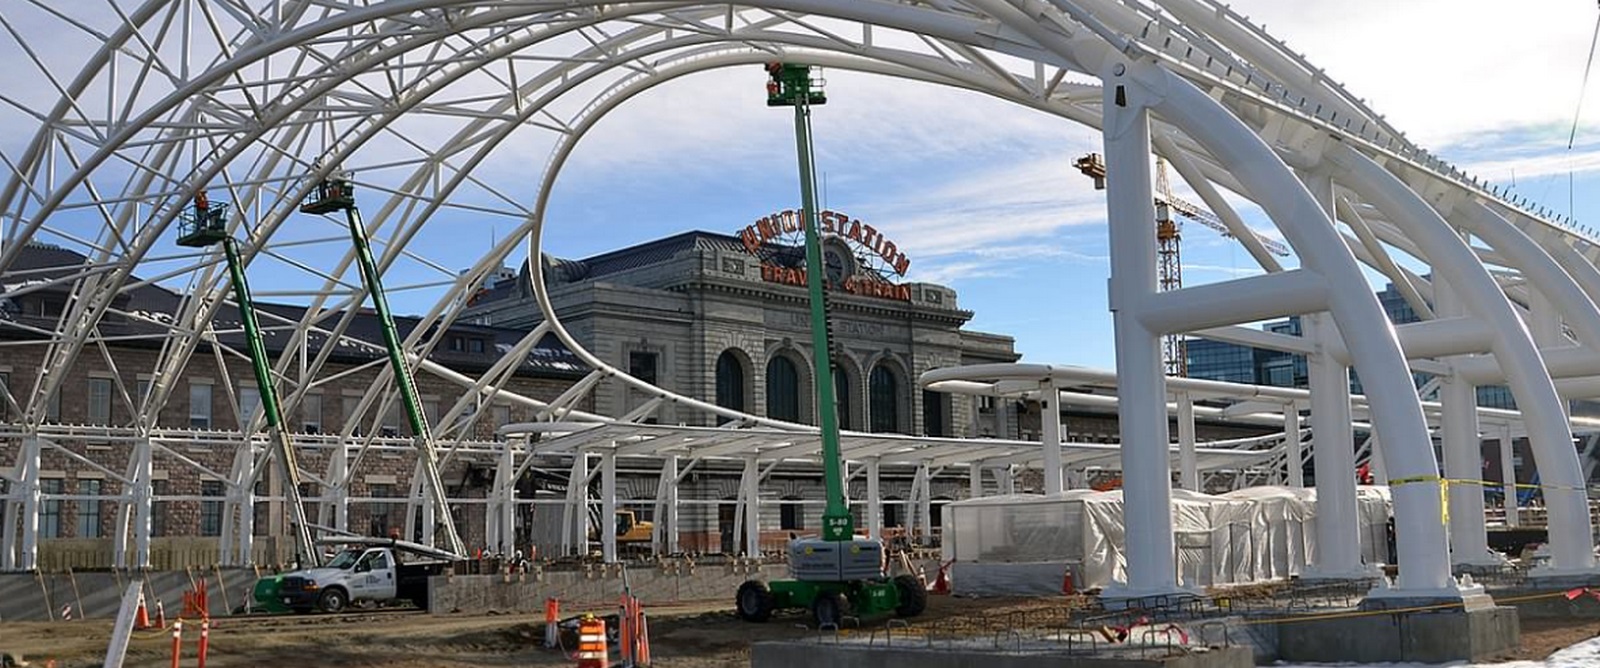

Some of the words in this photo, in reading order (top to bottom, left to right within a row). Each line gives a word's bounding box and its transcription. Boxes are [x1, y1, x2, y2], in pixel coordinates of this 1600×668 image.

[821, 210, 911, 277] STATION
[761, 263, 832, 289] TRAV
[863, 281, 911, 301] TRAIN
